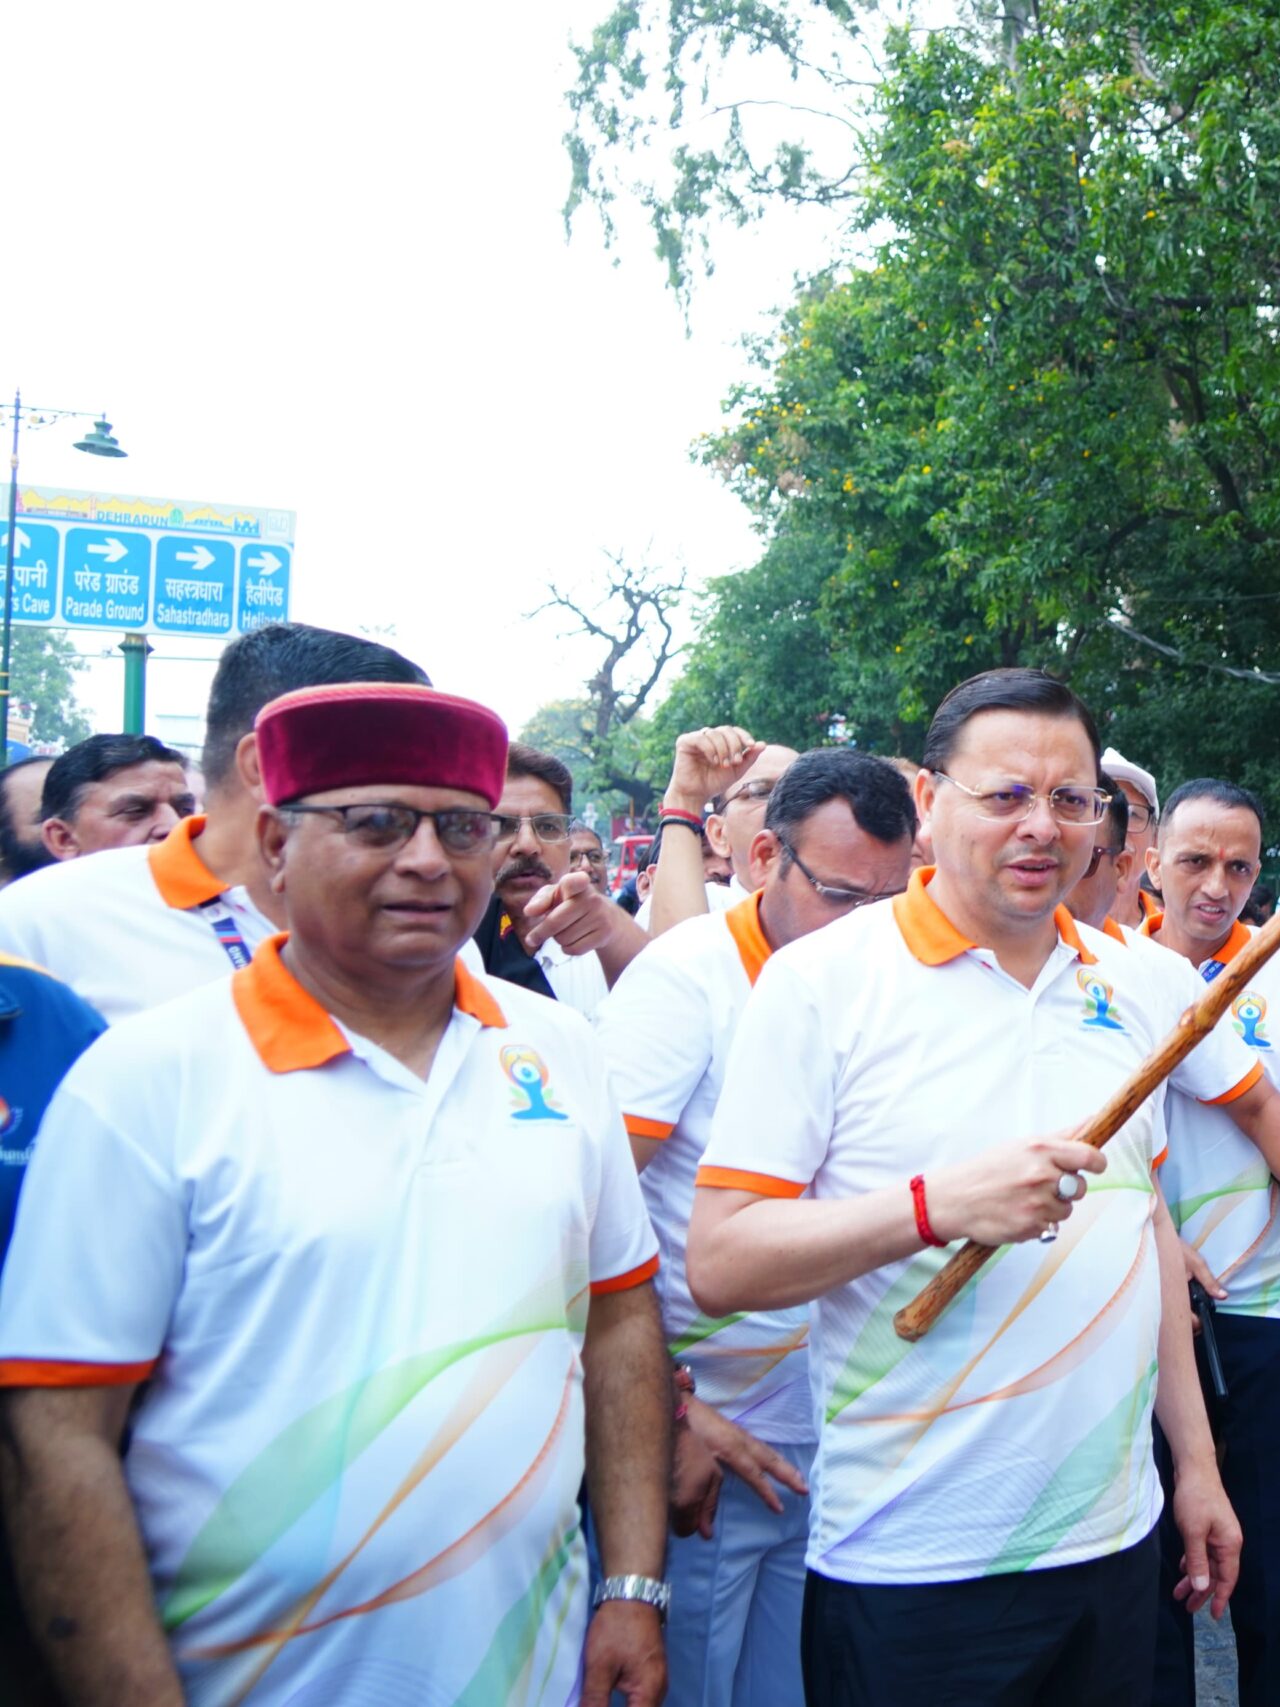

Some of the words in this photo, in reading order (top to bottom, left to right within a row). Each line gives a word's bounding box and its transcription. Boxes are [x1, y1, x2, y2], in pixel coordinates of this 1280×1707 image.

[97, 510, 169, 527] DEHRADUN
[74, 564, 101, 592] परेड
[105, 569, 139, 595] ग्राउंड
[22, 592, 50, 614] Cave
[65, 595, 103, 618] Parade
[106, 598, 144, 622] Ground
[157, 603, 230, 628] Sahastradhara
